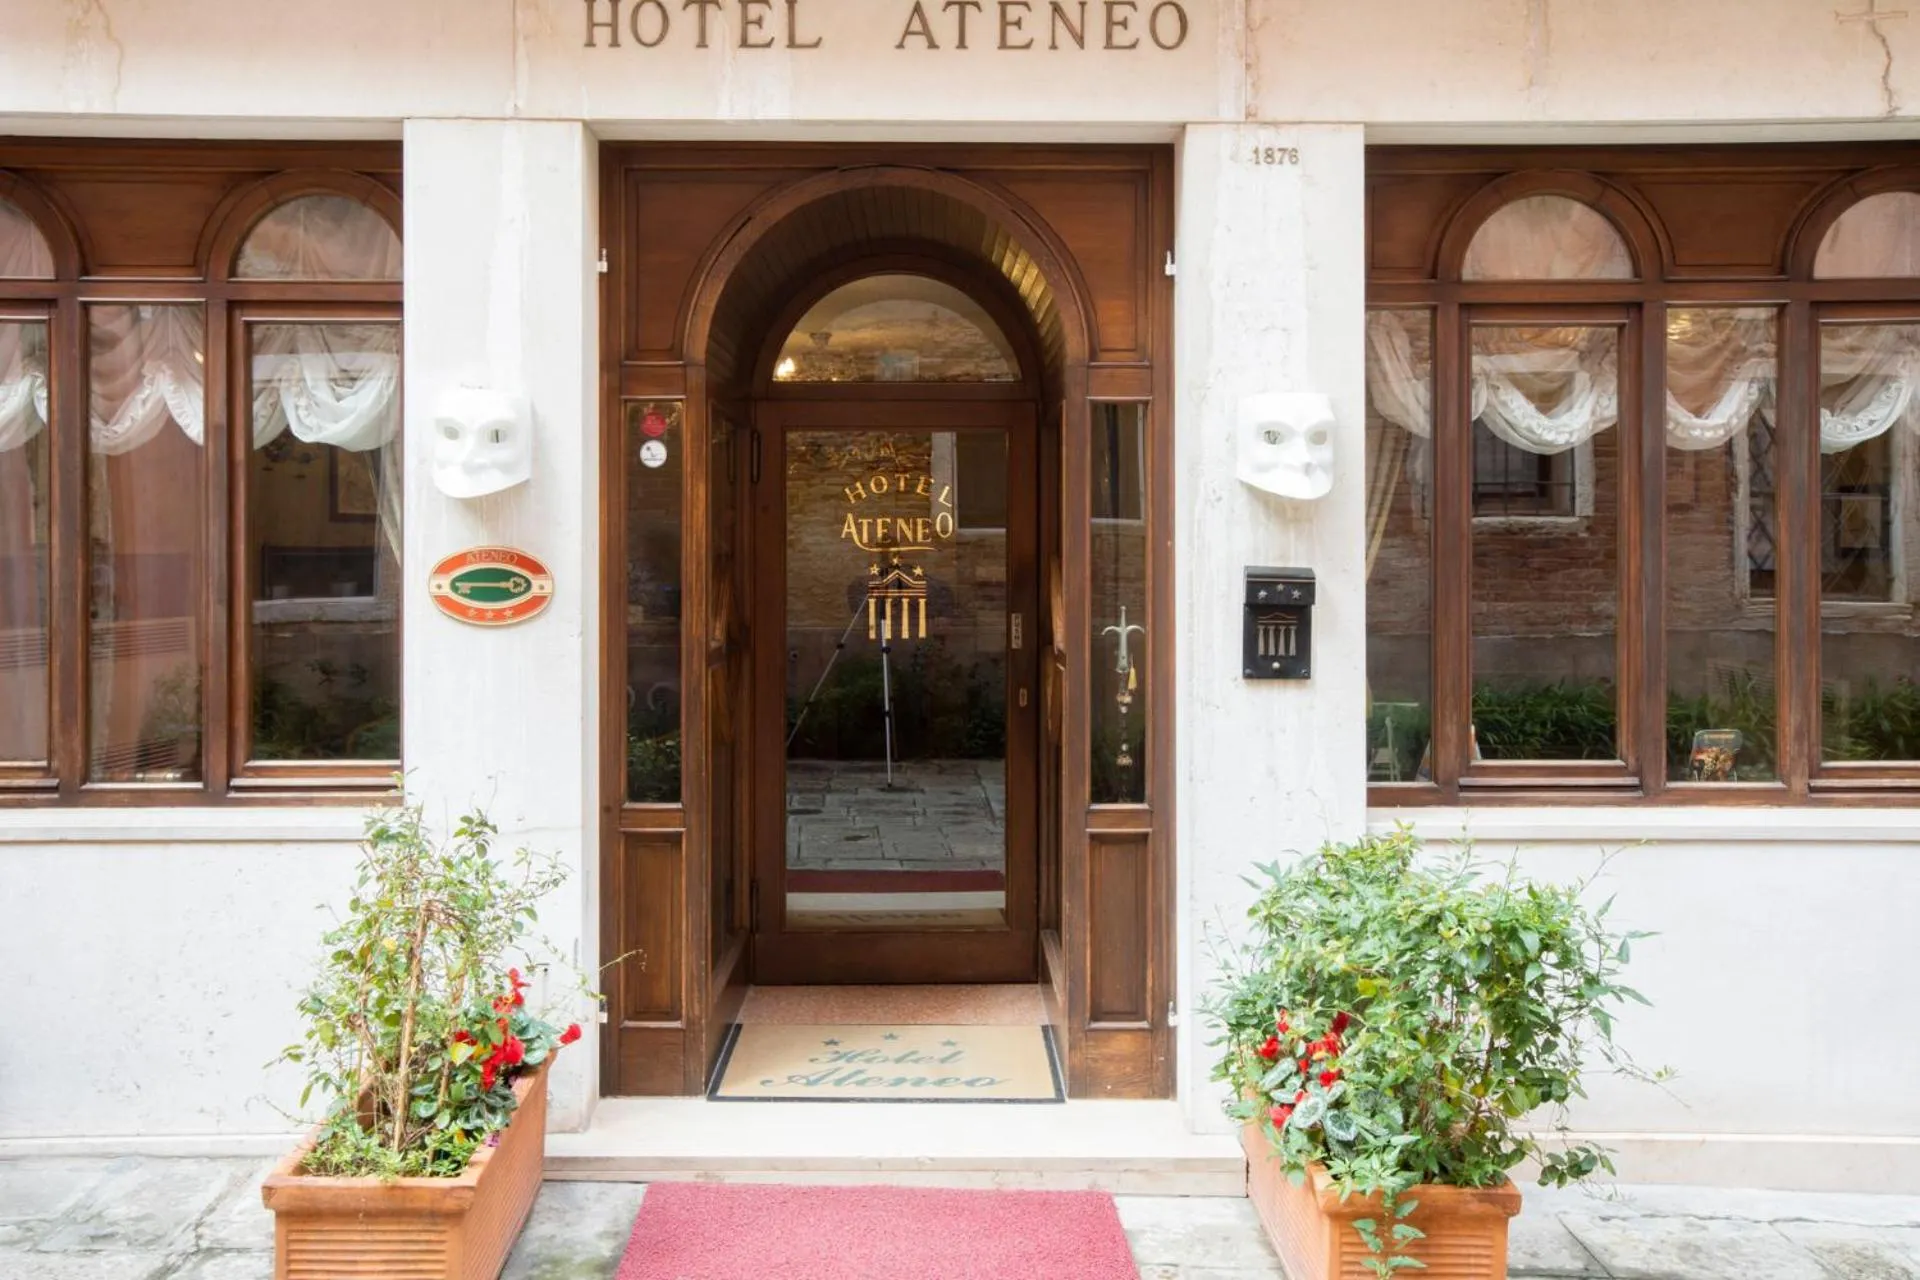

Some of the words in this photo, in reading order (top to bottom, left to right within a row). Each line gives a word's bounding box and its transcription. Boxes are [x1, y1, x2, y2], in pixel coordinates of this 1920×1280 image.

[584, 0, 823, 48] HOTEL
[895, 0, 1188, 50] ATENEO
[1252, 146, 1300, 165] 1876
[844, 473, 953, 508] HOTEL
[841, 512, 953, 552] ATENEO
[466, 550, 518, 564] ATENEO
[808, 1048, 965, 1065] Hotel
[760, 1066, 1013, 1087] Ateneo
